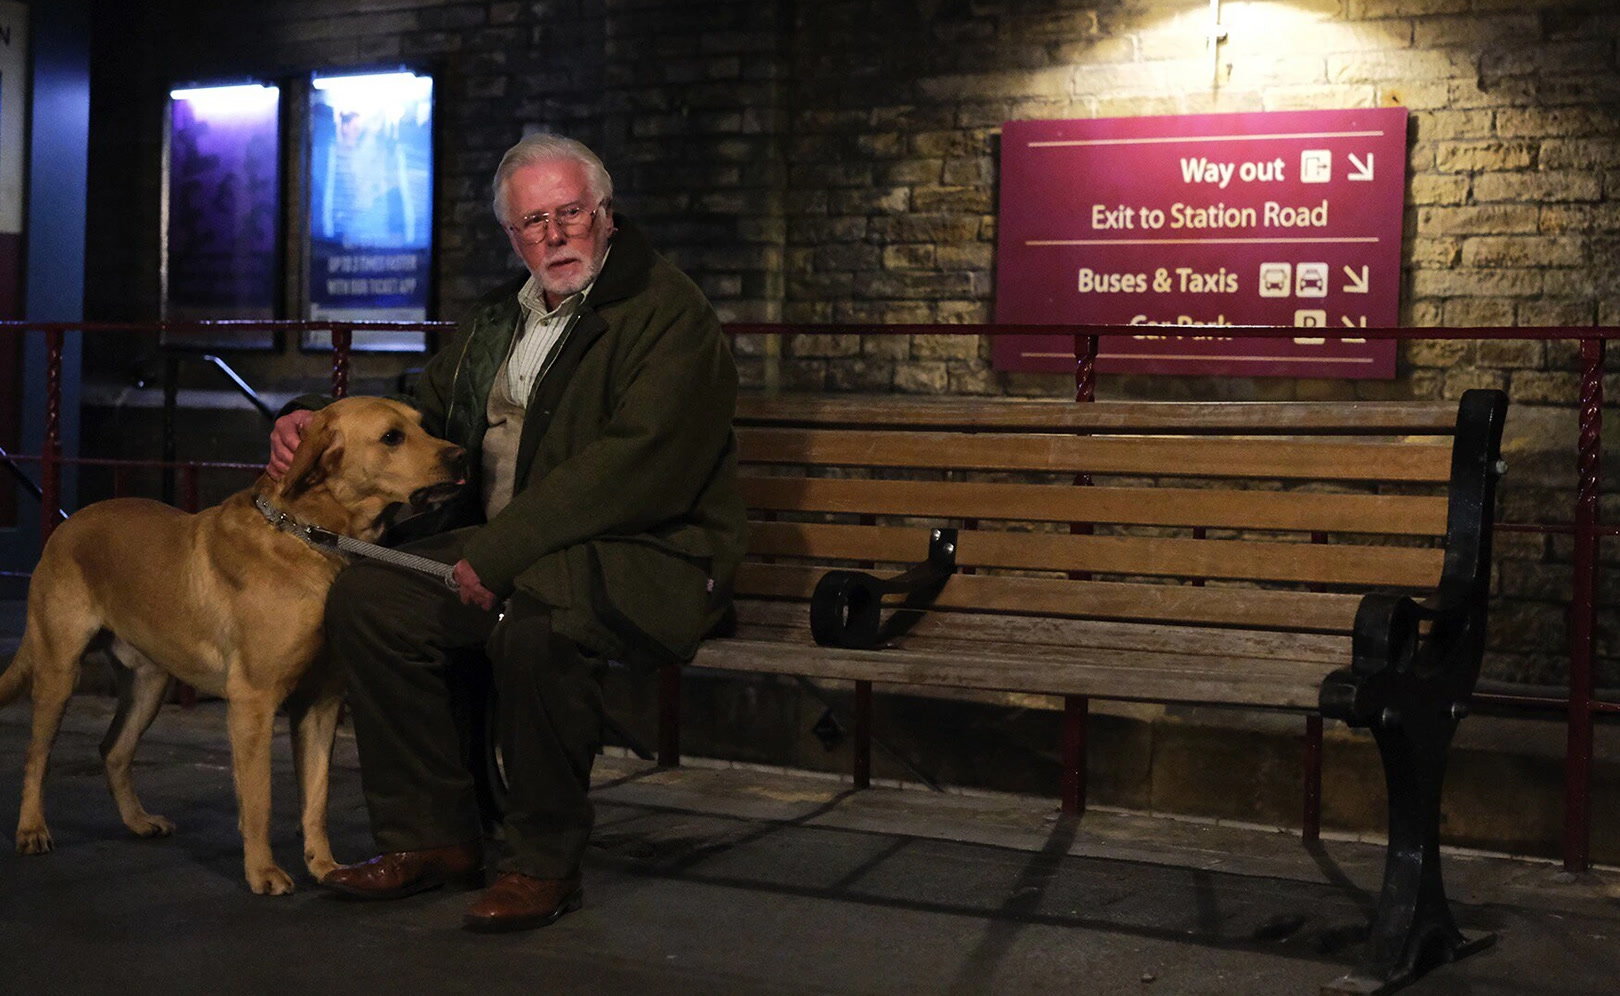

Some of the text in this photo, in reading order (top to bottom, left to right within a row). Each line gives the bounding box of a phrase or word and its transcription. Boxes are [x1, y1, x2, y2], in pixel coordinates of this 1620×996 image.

[1180, 157, 1286, 189] Way out
[1091, 199, 1329, 230] Exit to Station Road
[1077, 266, 1239, 294] Buses & Taxis
